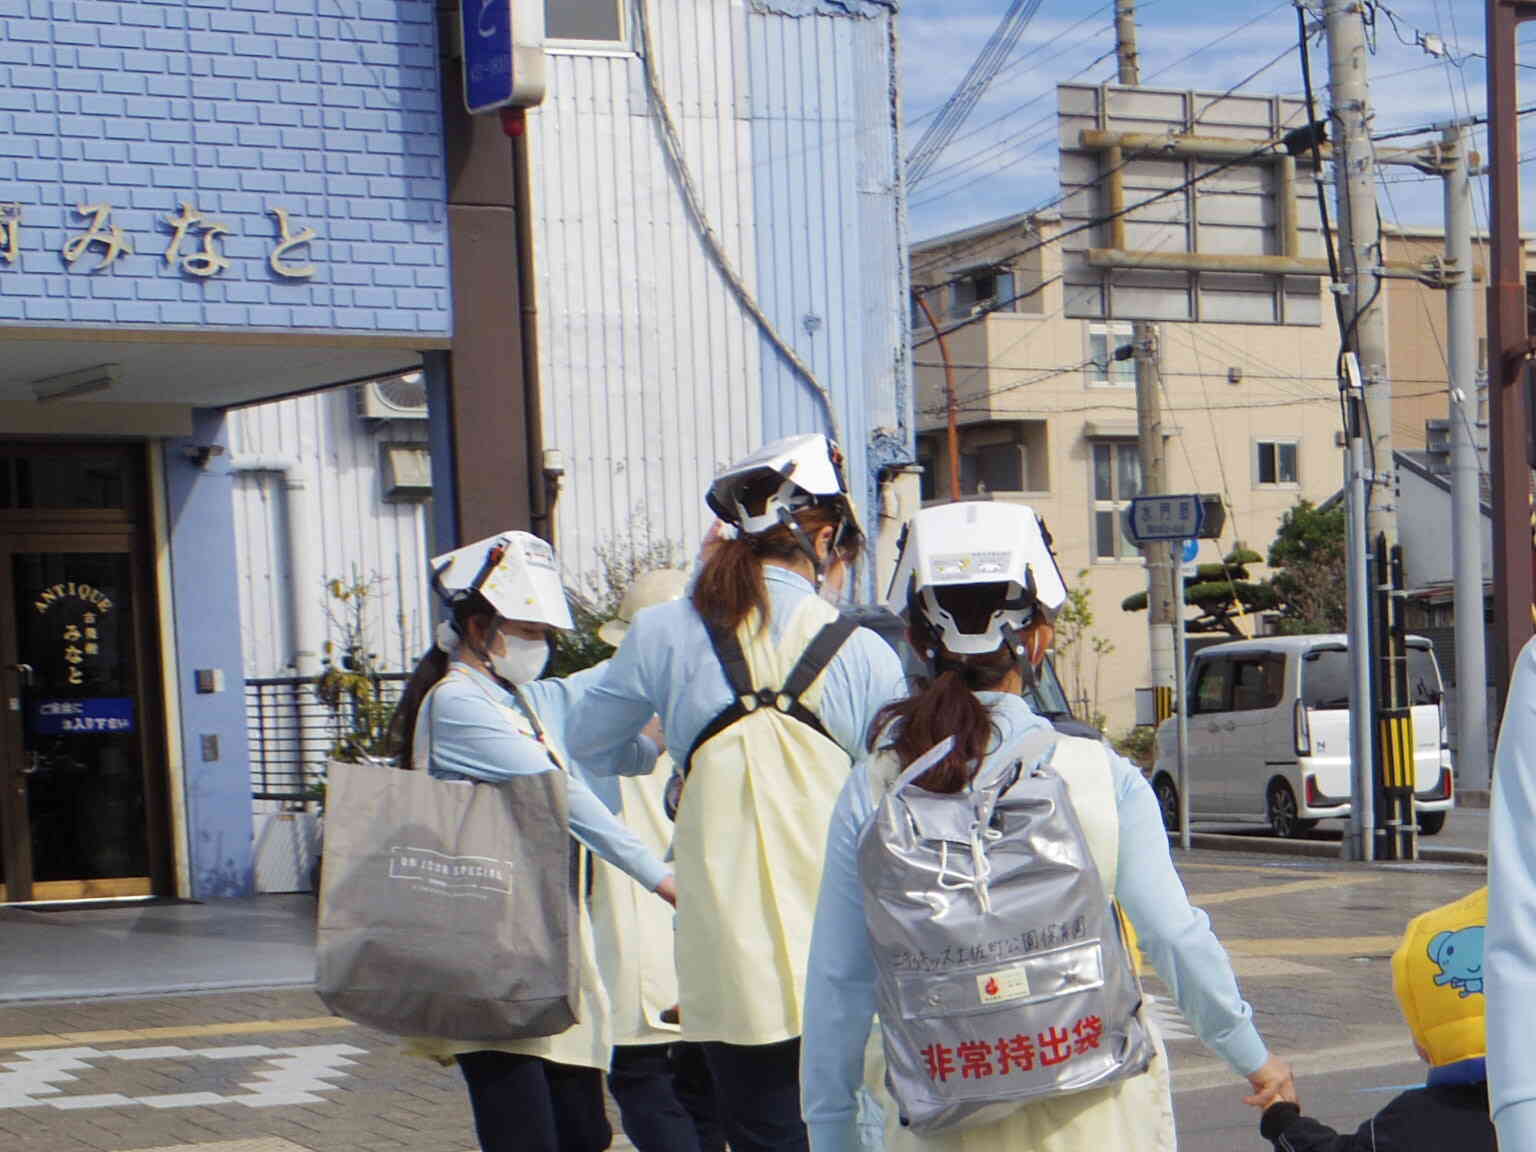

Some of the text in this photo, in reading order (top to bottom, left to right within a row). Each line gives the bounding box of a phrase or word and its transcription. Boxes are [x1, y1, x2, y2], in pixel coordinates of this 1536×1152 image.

[920, 1015, 1104, 1081] 非常持出袋
